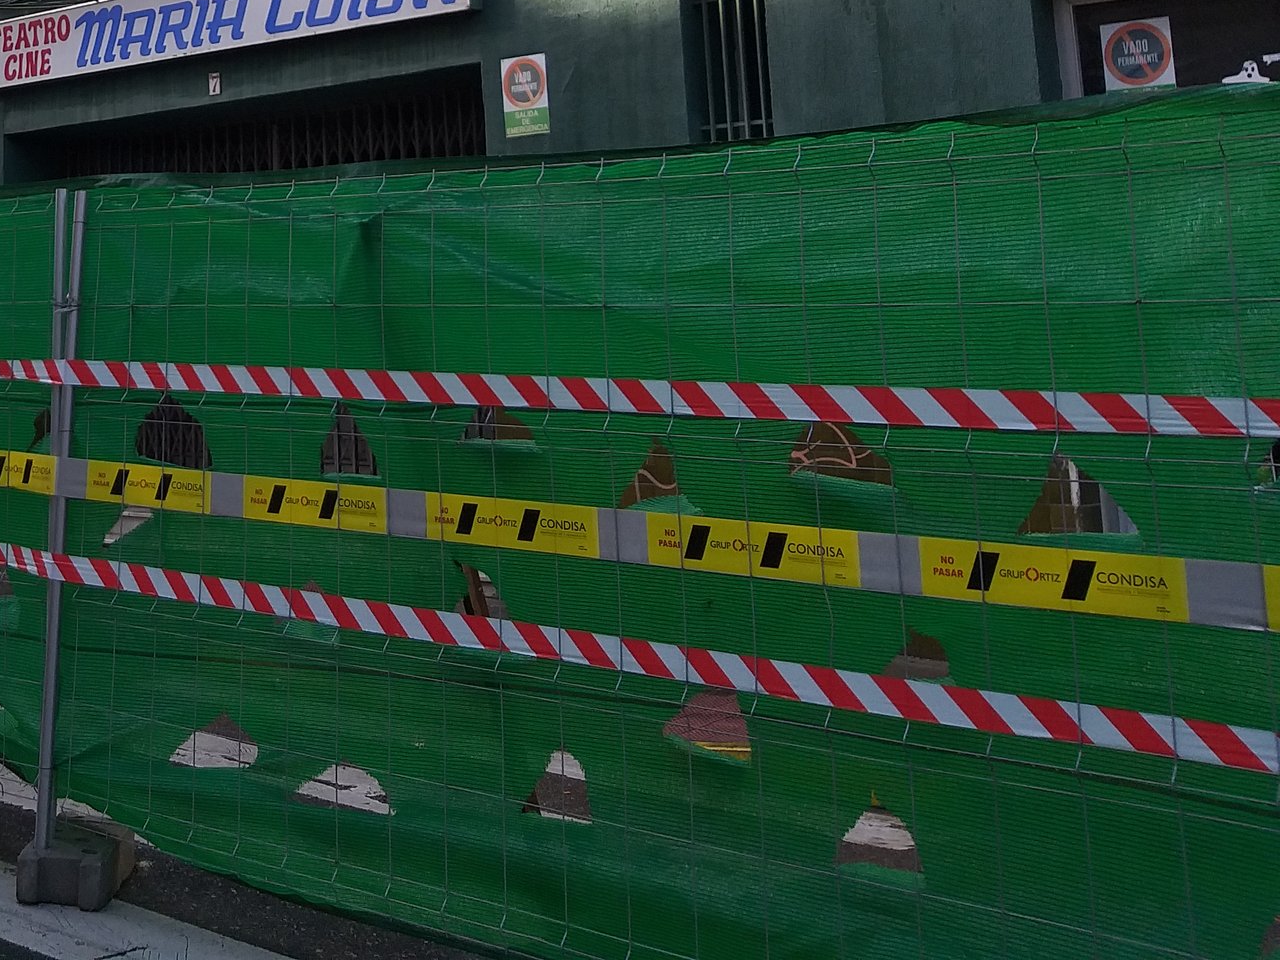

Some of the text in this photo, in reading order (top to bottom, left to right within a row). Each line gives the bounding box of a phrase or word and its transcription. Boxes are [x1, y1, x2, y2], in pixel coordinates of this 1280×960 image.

[1122, 38, 1149, 55] VADO
[4, 48, 52, 82] CINE
[514, 70, 532, 83] VADO
[211, 75, 219, 93] 7
[171, 481, 203, 492] CONDISA
[338, 498, 376, 510] CONDISA
[540, 519, 587, 532] CONDISA
[664, 529, 675, 537] NO
[787, 543, 845, 558] CONDISA
[940, 555, 954, 565] NO
[933, 567, 964, 578] PASAR
[1096, 572, 1168, 589] CONDISA
